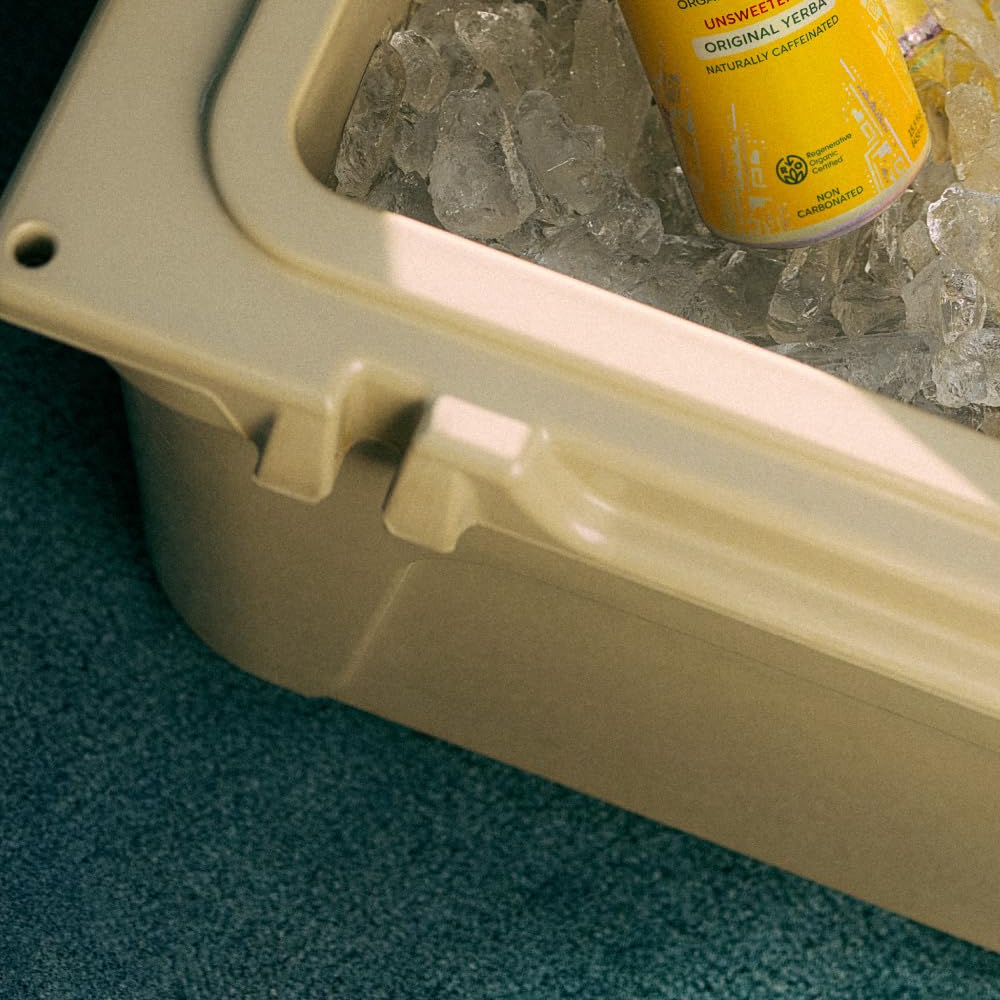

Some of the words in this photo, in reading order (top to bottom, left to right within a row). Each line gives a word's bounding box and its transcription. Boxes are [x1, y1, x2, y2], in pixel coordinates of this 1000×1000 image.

[704, 24, 780, 53] ORIGINAL
[706, 51, 769, 75] NATURALLY
[771, 14, 839, 57] CAFFEINATED
[805, 133, 852, 158] Regenerative
[808, 150, 839, 167] Organic
[811, 156, 844, 174] Certified
[797, 185, 864, 218] CARBONATED
[816, 187, 841, 203] NON
